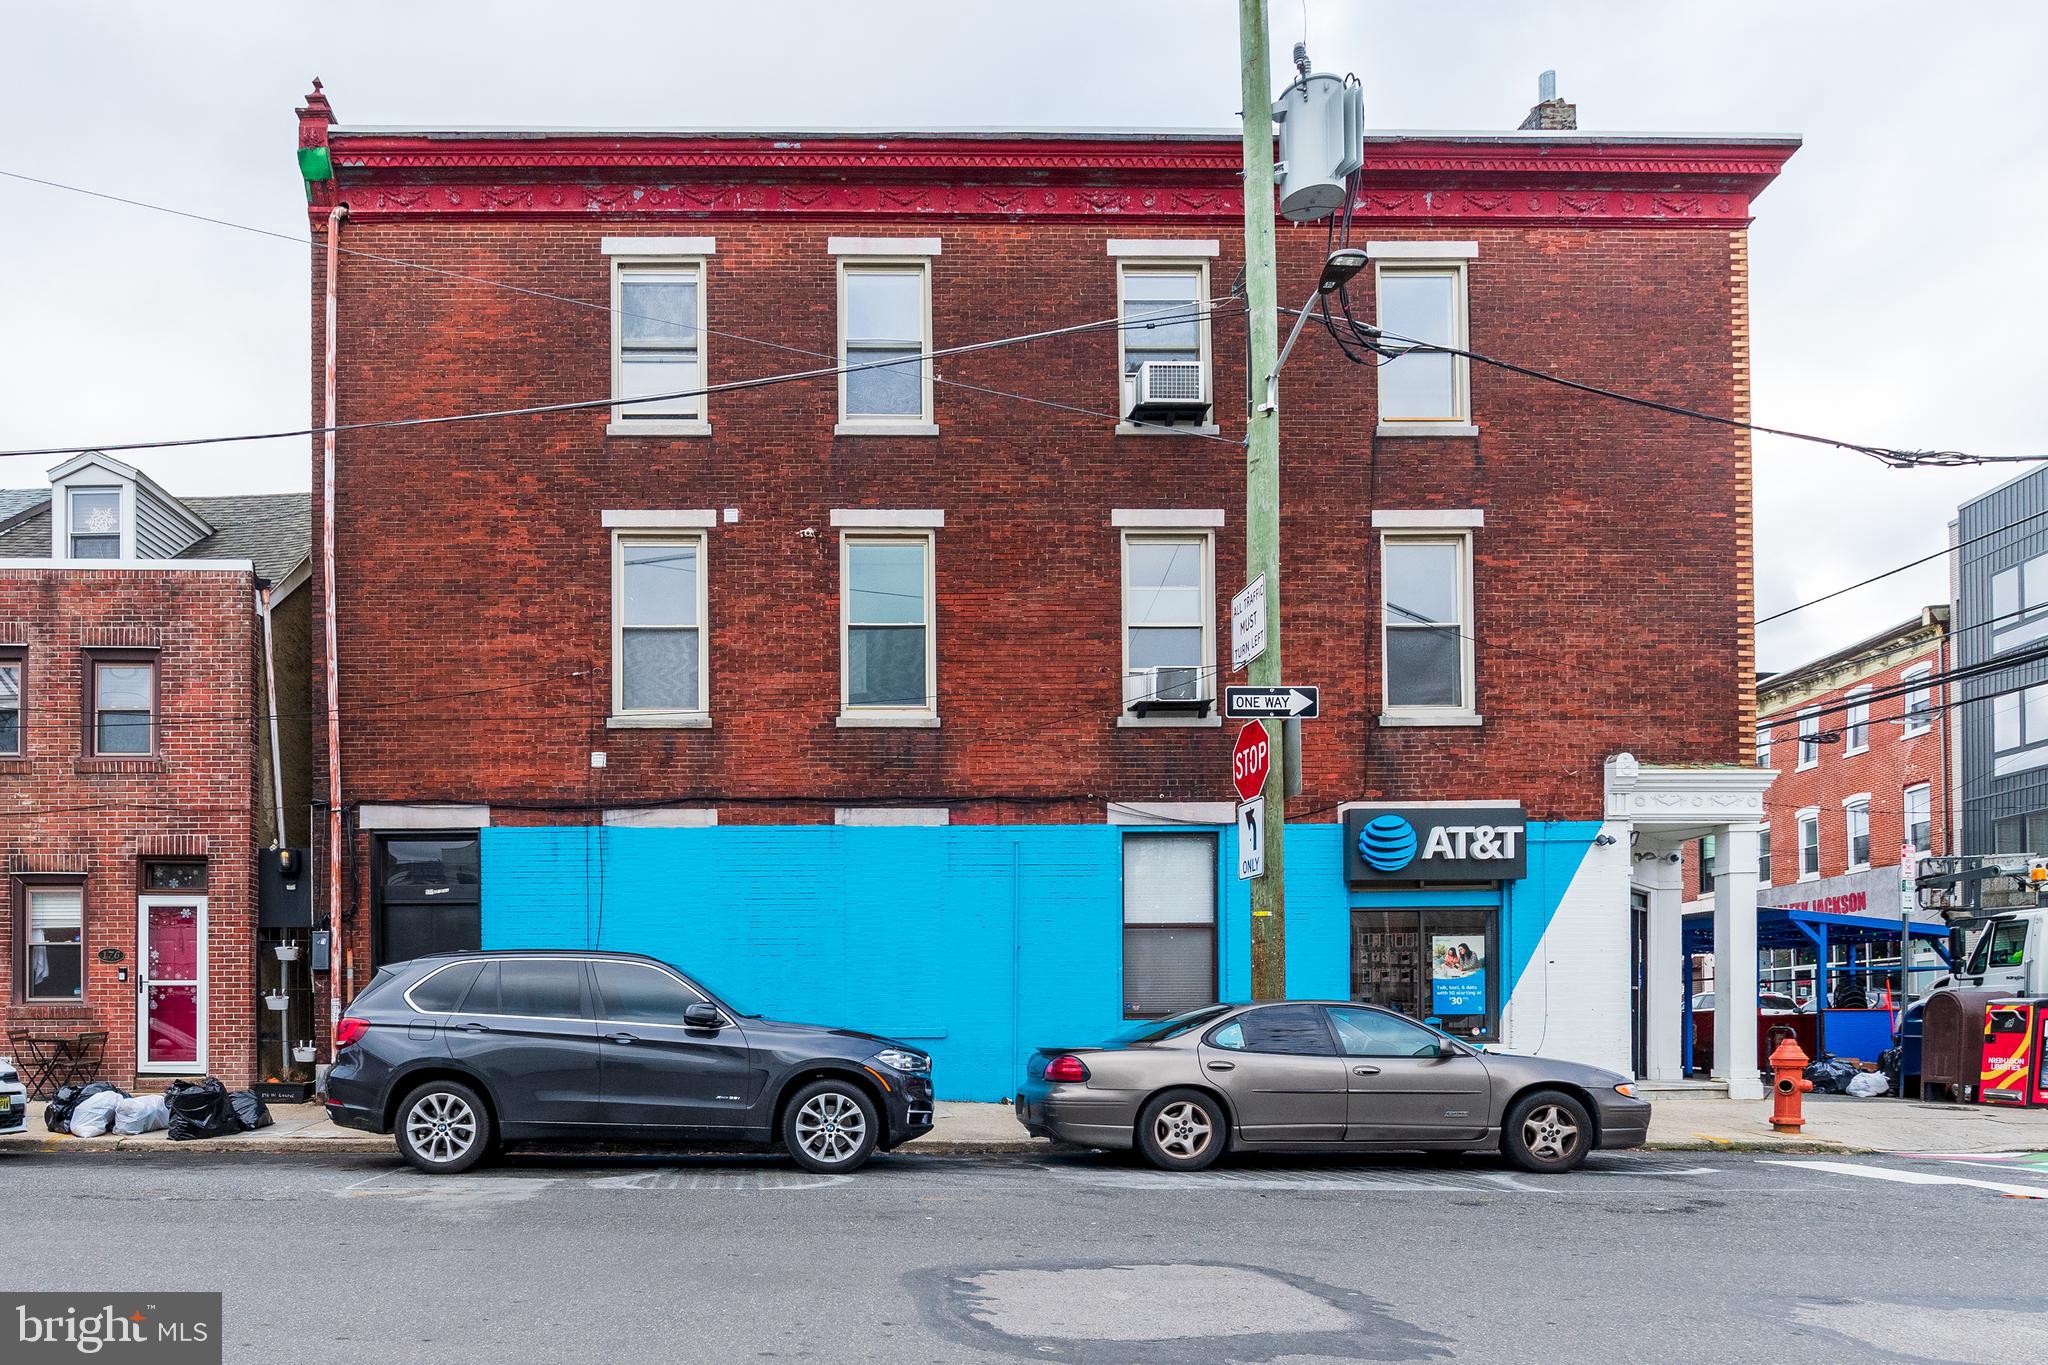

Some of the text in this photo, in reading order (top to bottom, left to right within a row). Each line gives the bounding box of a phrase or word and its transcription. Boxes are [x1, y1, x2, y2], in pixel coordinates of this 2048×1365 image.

[1233, 584, 1264, 616] ALL TRAFFIC
[1239, 610, 1257, 636] MUST
[1234, 629, 1264, 661] TURN LEFT
[1236, 696, 1290, 708] ONE WAY
[1235, 740, 1267, 780] STOP
[1421, 825, 1524, 861] AT&T
[1242, 857, 1260, 874] ONLY
[1812, 891, 1866, 914] JACKSON
